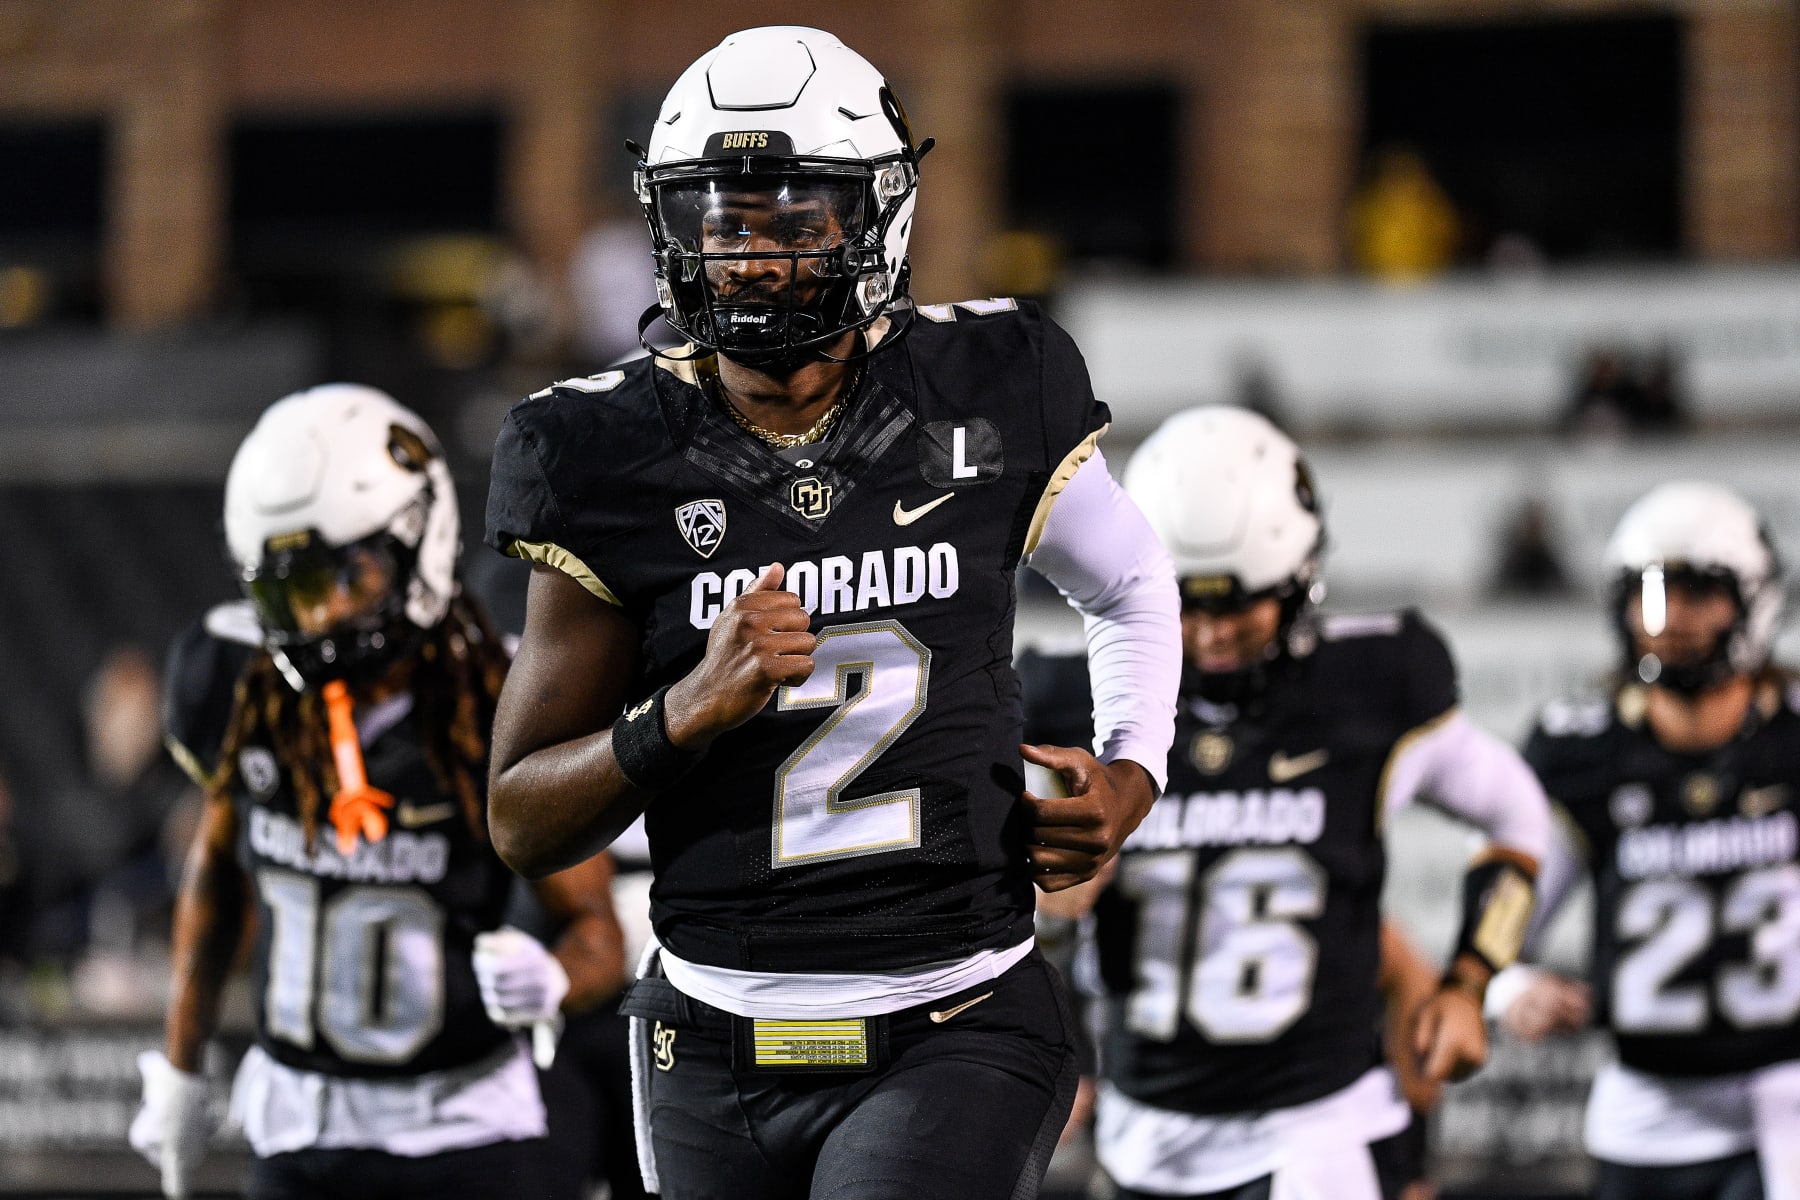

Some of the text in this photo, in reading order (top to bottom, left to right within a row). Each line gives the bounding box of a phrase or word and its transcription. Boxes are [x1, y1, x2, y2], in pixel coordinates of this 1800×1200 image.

[722, 132, 769, 149] BUFFS
[730, 315, 767, 324] Riddell
[952, 426, 978, 480] L
[678, 501, 723, 539] PAC
[790, 477, 833, 520] CU
[693, 524, 717, 547] 12
[689, 542, 959, 630] COORADO
[772, 619, 932, 869] 2
[256, 866, 447, 1065] 10
[1120, 848, 1329, 1044] 16
[1611, 868, 1800, 1031] 23
